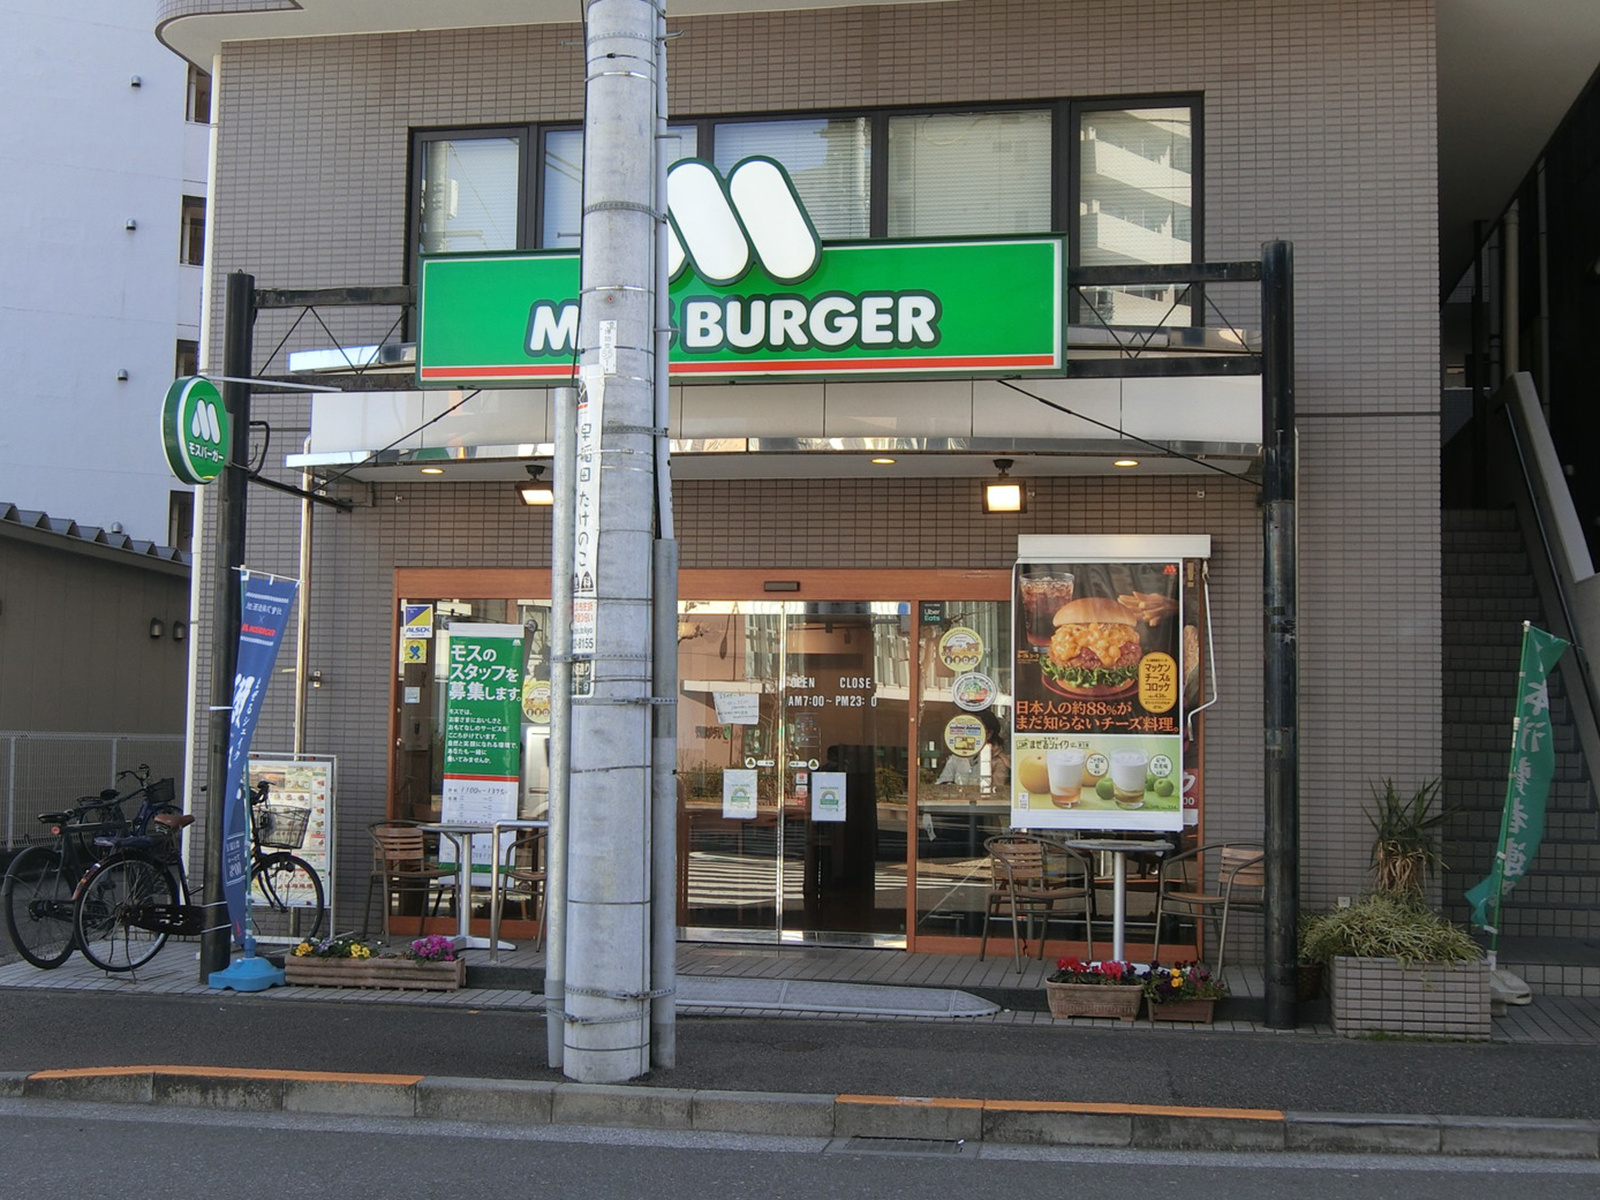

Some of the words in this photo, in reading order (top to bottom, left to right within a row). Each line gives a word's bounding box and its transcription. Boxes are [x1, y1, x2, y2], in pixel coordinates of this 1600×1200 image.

[686, 296, 937, 349] BURGER
[188, 441, 224, 463] モスバーガー
[405, 626, 431, 634] ALSOK
[451, 644, 497, 662] モスの
[450, 664, 520, 683] スタッフを
[1144, 663, 1171, 672] マッケン
[449, 681, 522, 702] 募集します。
[790, 677, 815, 689] OPEN
[839, 677, 871, 689] CLOSE
[1144, 682, 1171, 692] コロッケ
[1016, 699, 1132, 716] 日本人の約88%が
[1016, 715, 1179, 733] まだ知らないチーズ料理。
